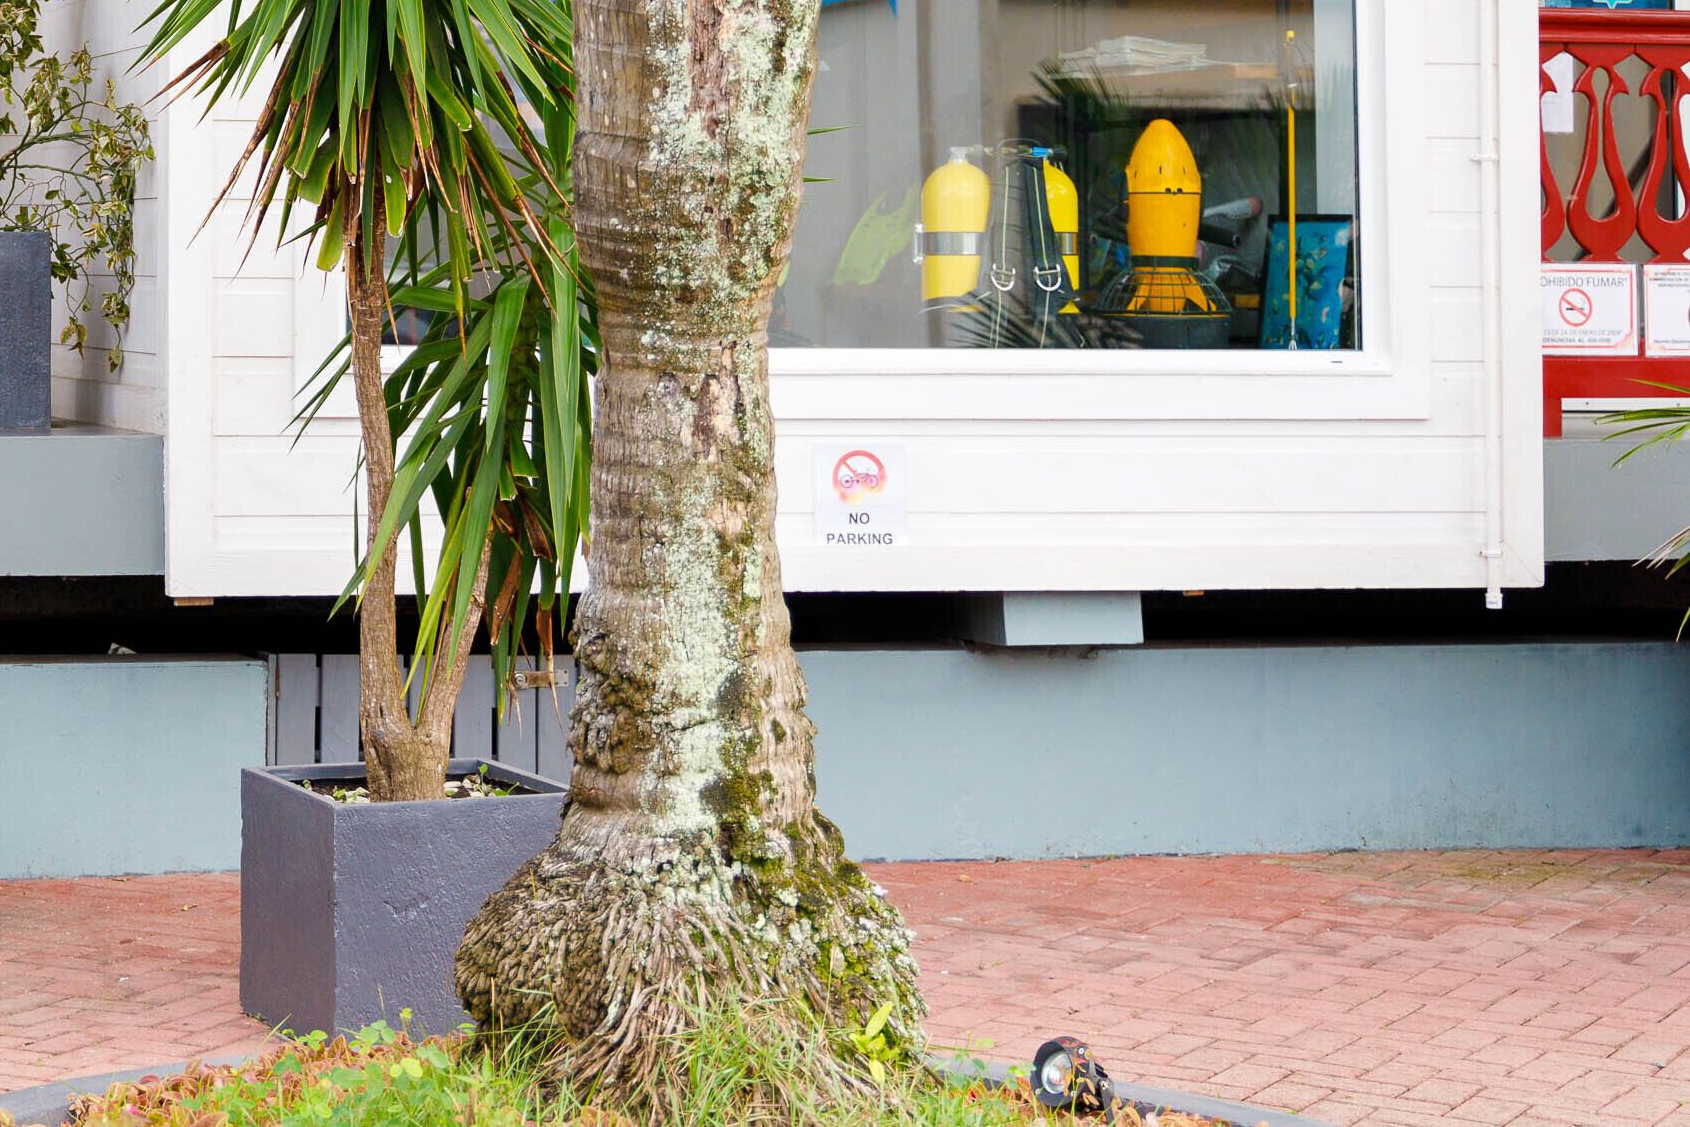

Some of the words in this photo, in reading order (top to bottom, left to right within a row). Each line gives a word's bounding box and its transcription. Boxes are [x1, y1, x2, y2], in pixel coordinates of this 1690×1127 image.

[1541, 277, 1583, 287] OHIBIDO
[849, 512, 870, 524] NO
[826, 532, 893, 545] PARKING
